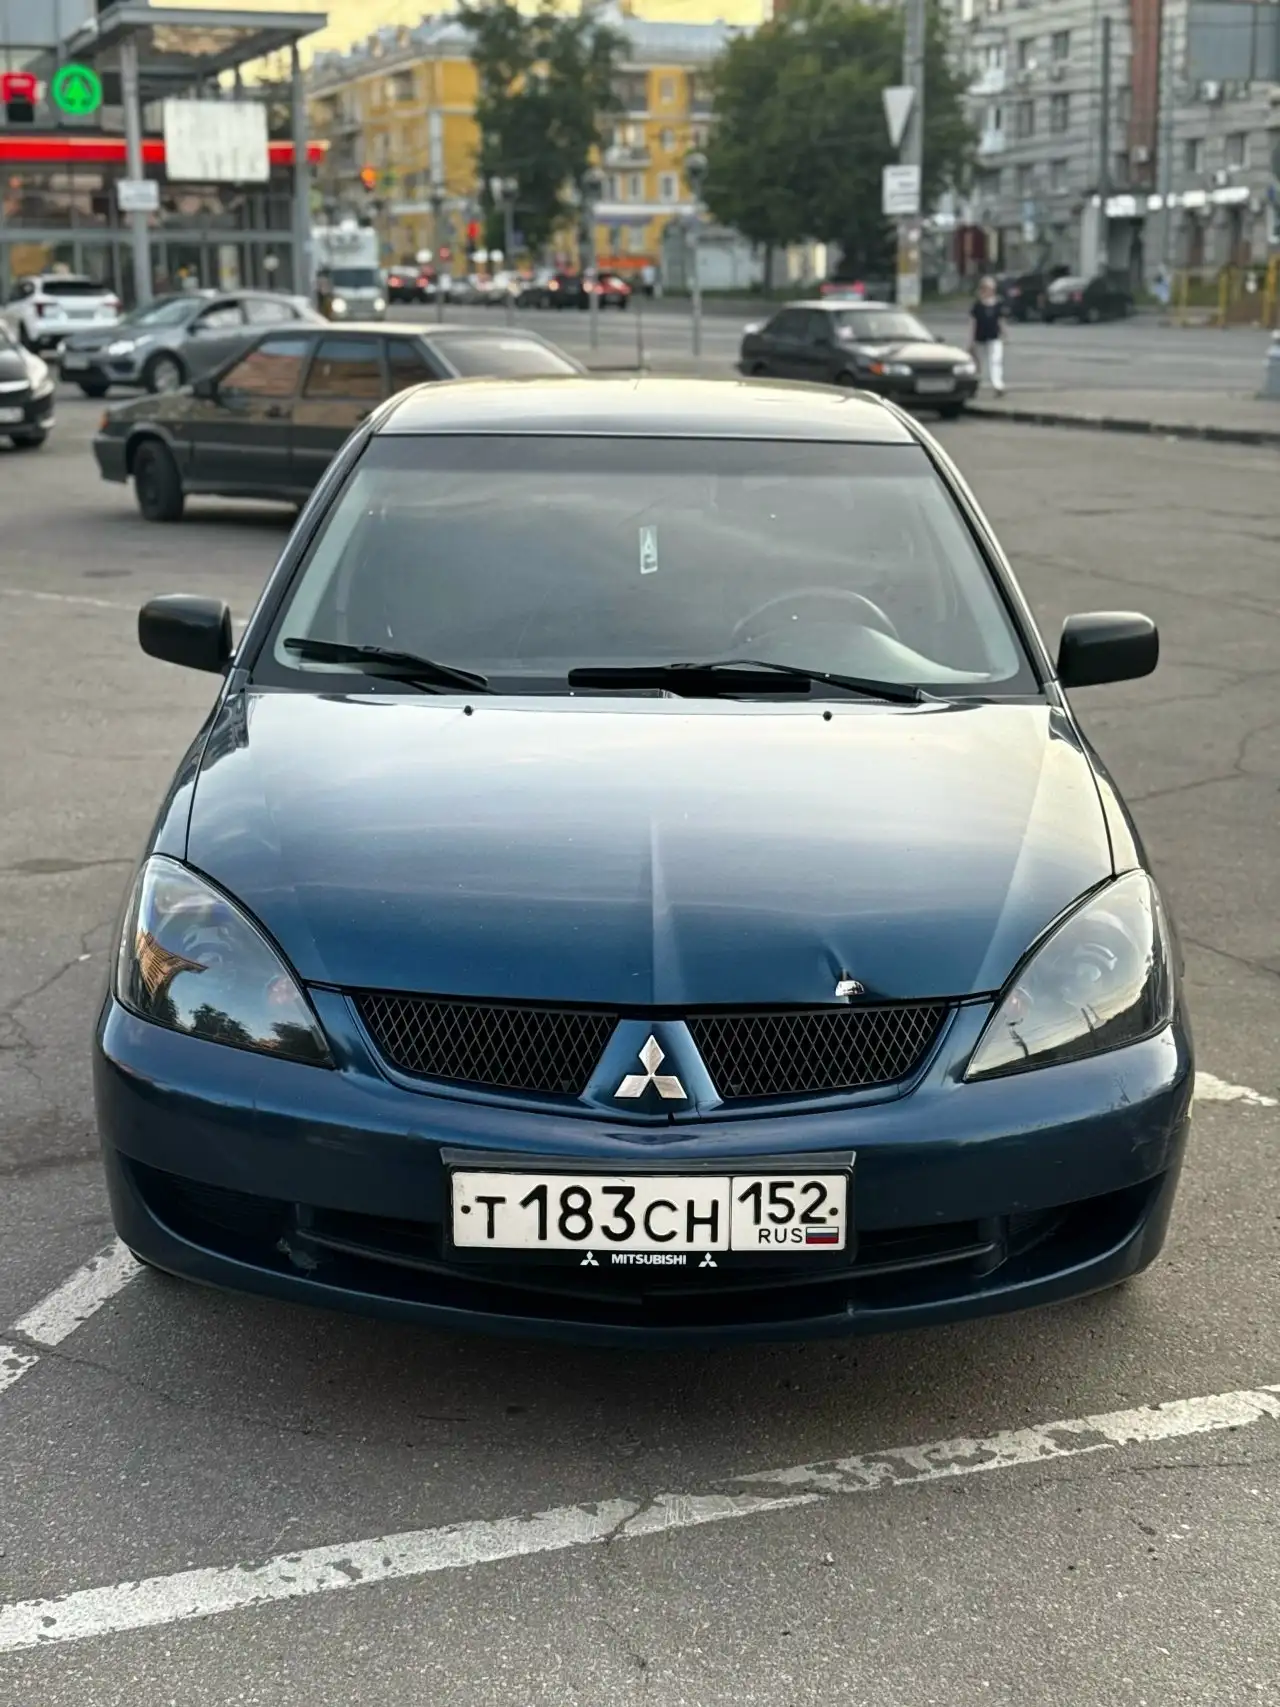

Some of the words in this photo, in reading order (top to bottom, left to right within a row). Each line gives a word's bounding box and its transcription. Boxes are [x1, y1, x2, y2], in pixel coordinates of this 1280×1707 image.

[737, 1181, 828, 1225] 152
[758, 1228, 803, 1244] RUS
[611, 1253, 687, 1265] MITSUBISHI
